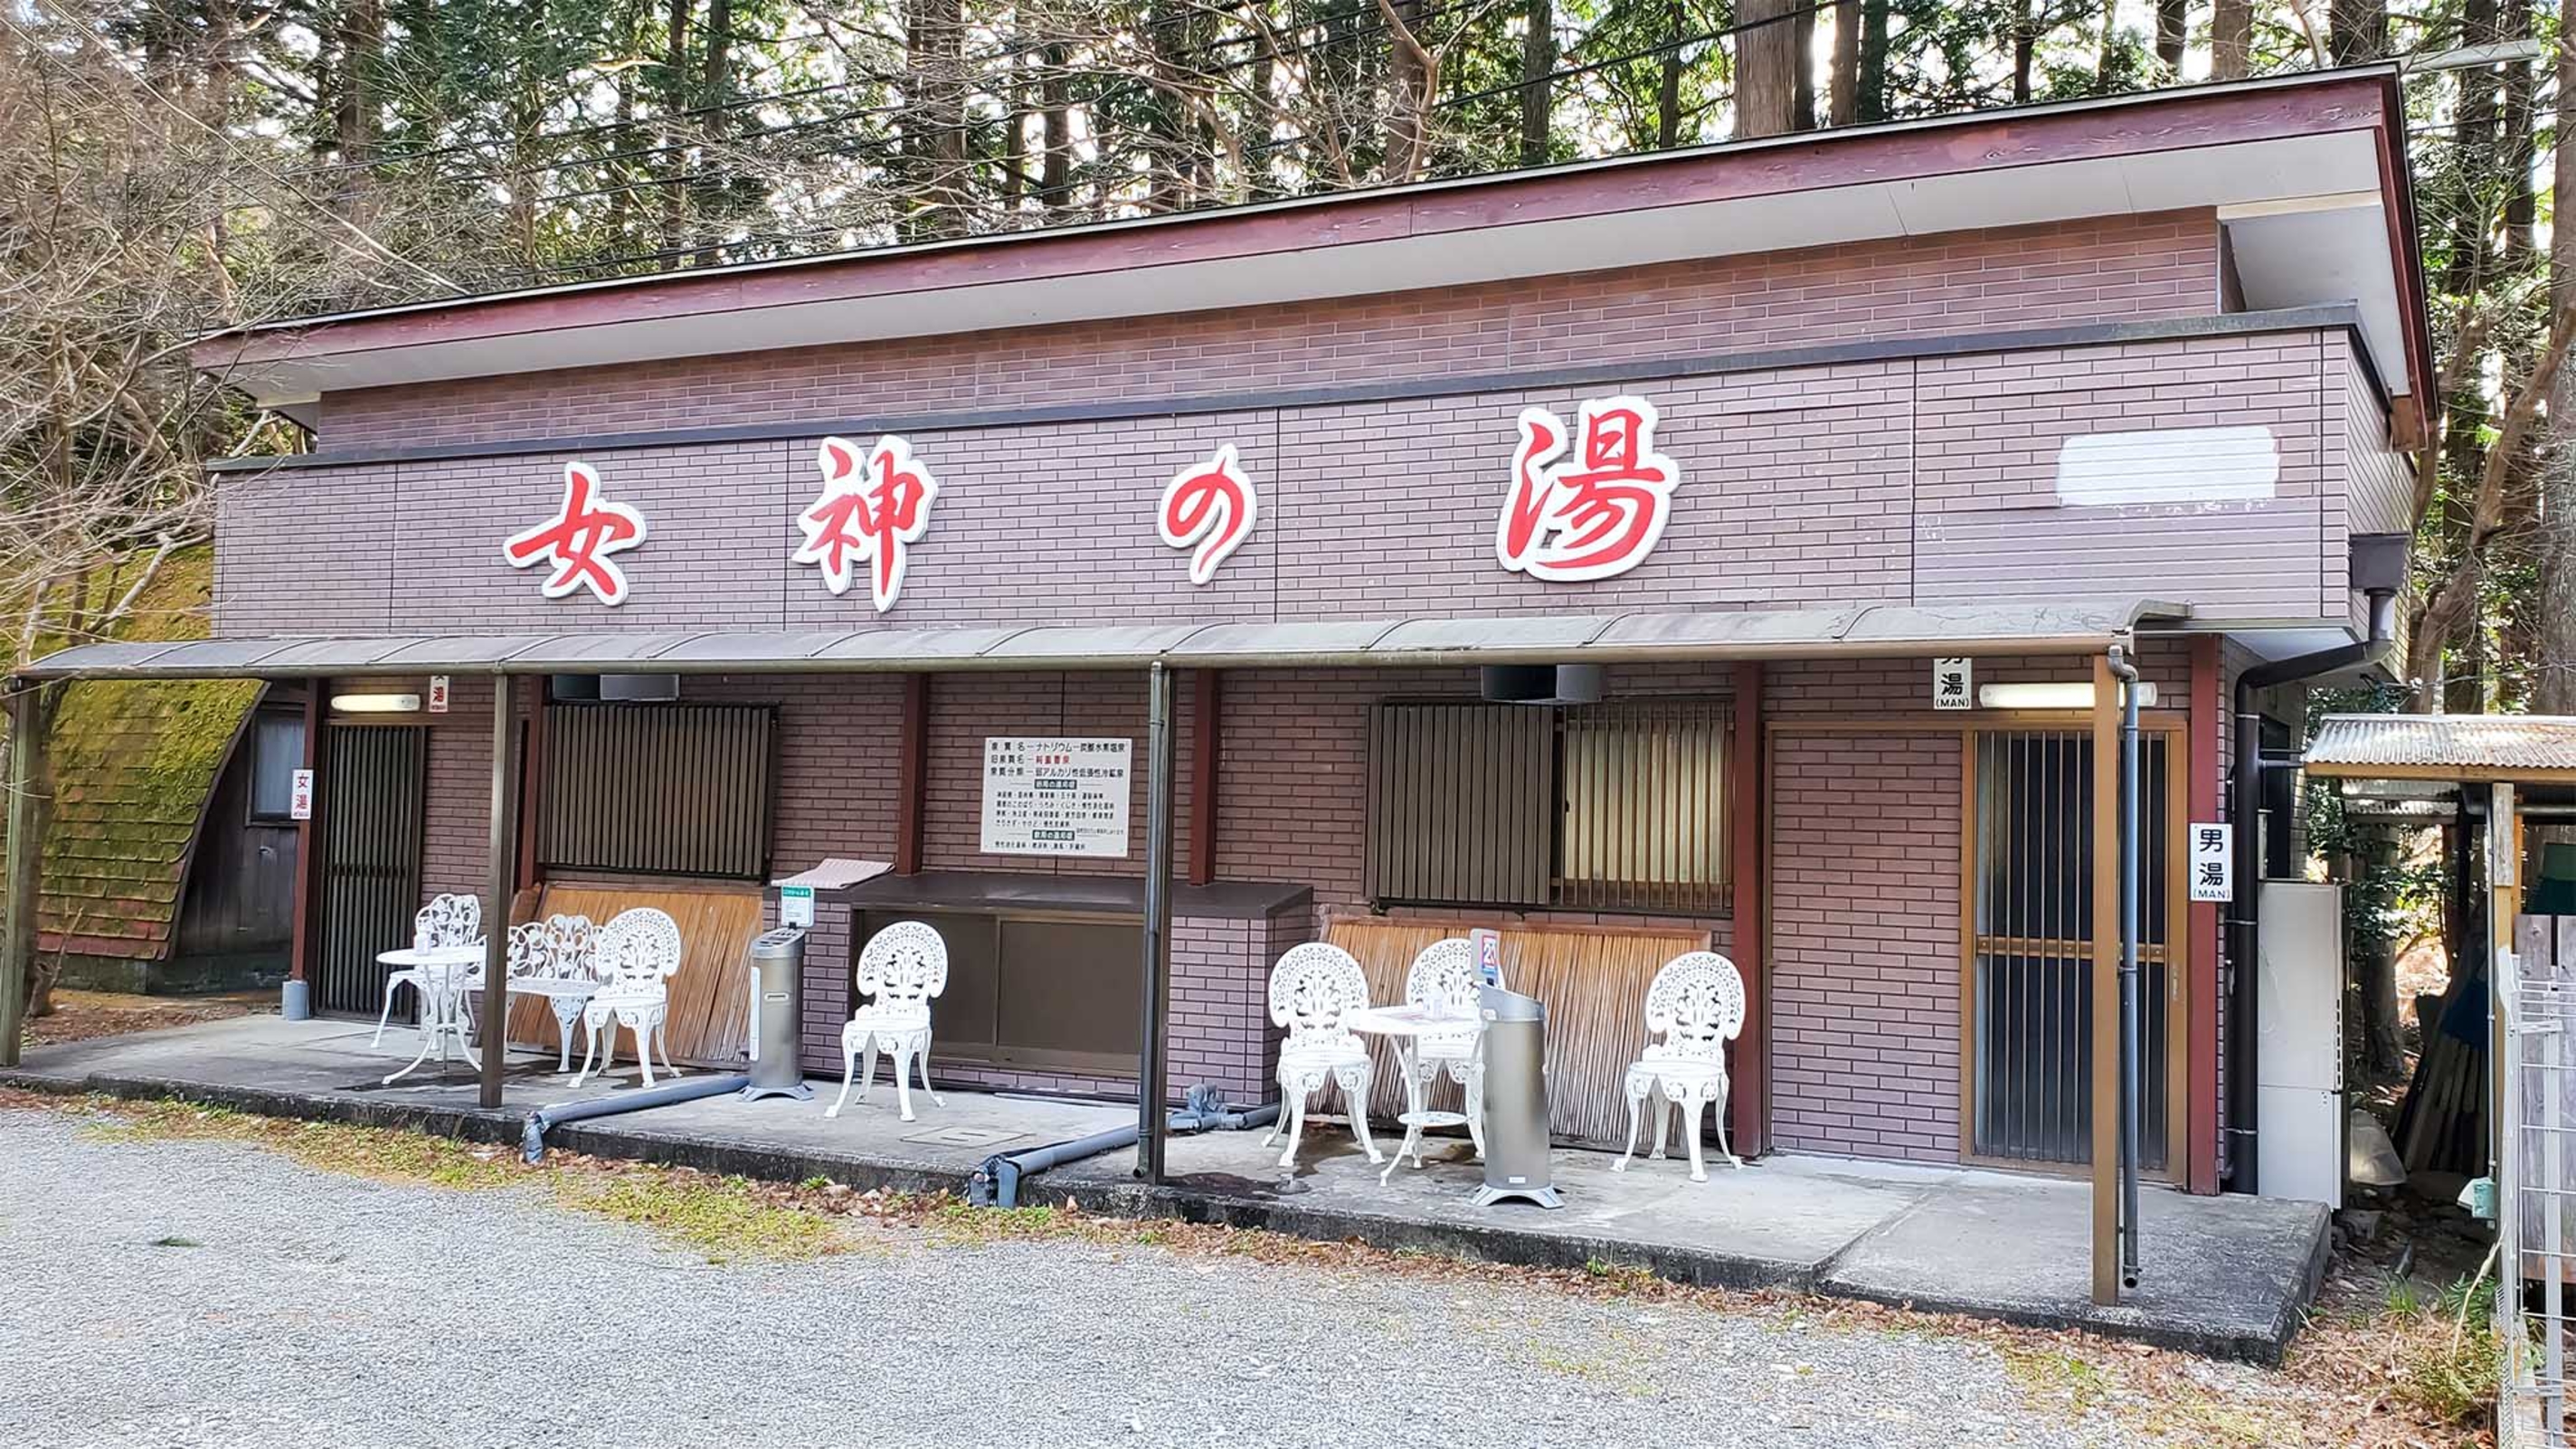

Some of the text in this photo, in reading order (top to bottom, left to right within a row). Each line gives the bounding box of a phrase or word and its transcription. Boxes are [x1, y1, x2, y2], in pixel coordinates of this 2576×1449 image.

[505, 401, 1675, 604] 女神の湯
[1935, 698, 1970, 708] (MAN)
[2199, 829, 2224, 886] 男湯
[2193, 889, 2230, 899] (MAN)
